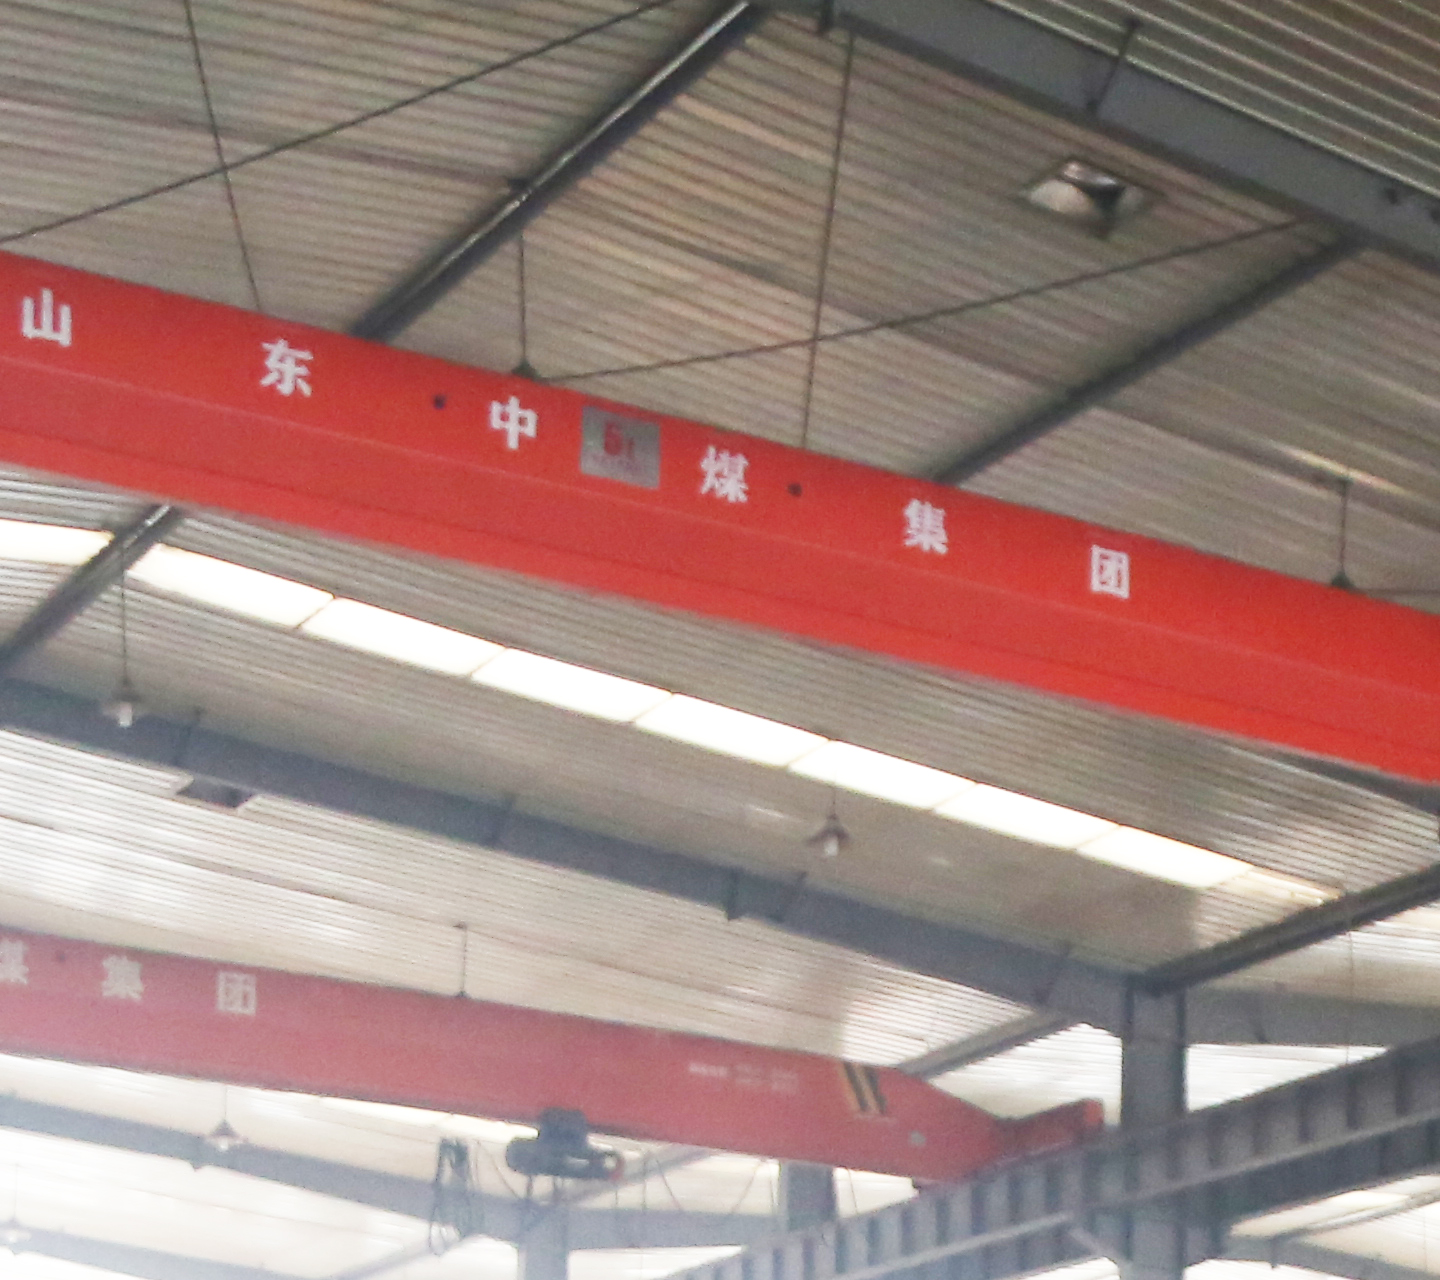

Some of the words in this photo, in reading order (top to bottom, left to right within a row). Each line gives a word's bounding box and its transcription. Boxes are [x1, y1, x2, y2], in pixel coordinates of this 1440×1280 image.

[21, 287, 1132, 600] 山东中煤集团
